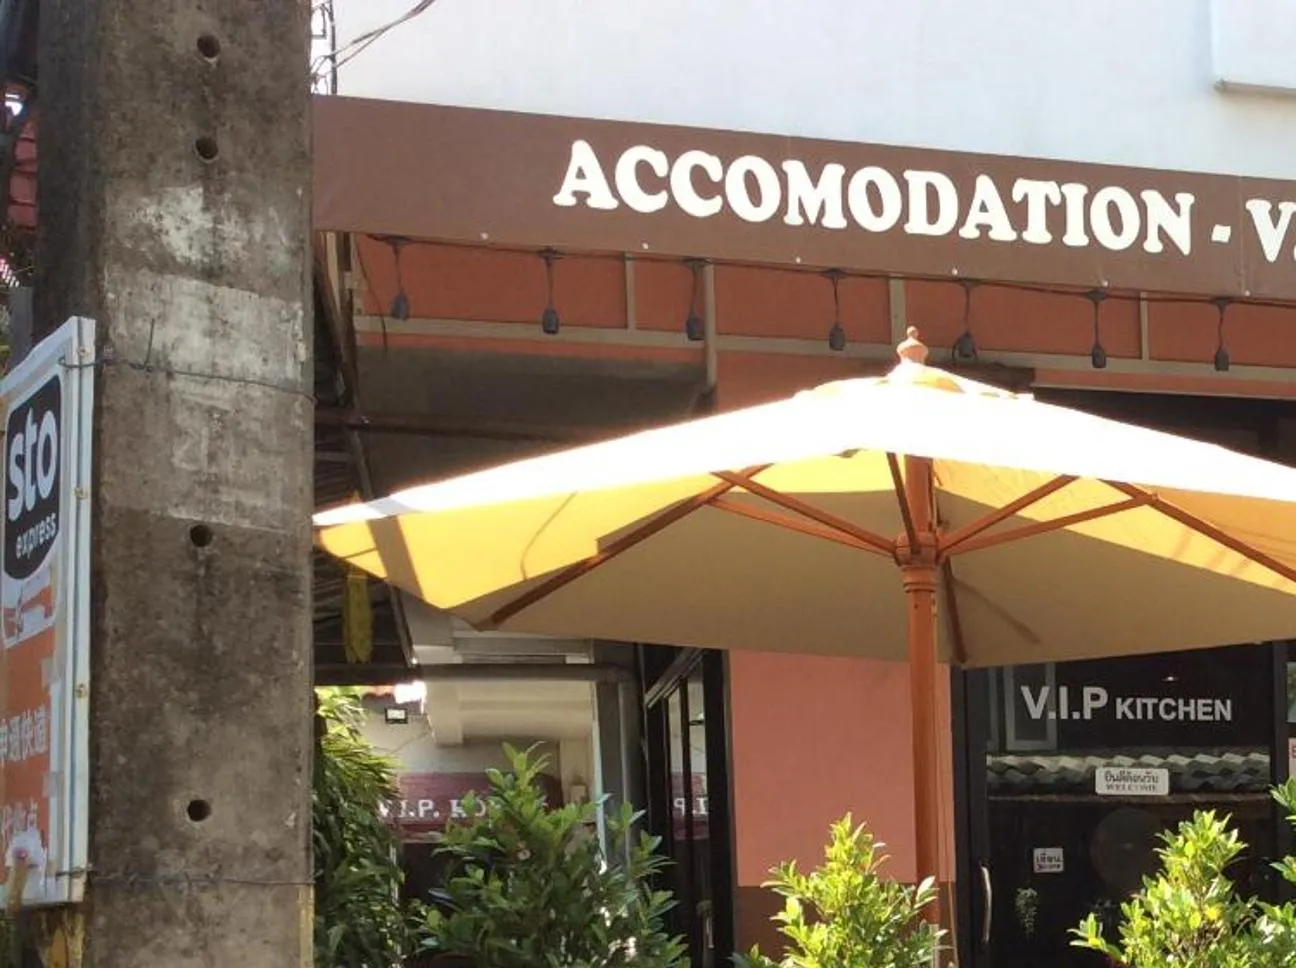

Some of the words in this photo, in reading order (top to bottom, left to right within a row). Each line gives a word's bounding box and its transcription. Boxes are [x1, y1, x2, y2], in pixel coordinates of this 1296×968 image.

[552, 139, 1195, 255] ACCOMODATION
[8, 407, 57, 522] sto
[1021, 686, 1108, 719] V.I.P
[1116, 698, 1232, 721] KITCHEN
